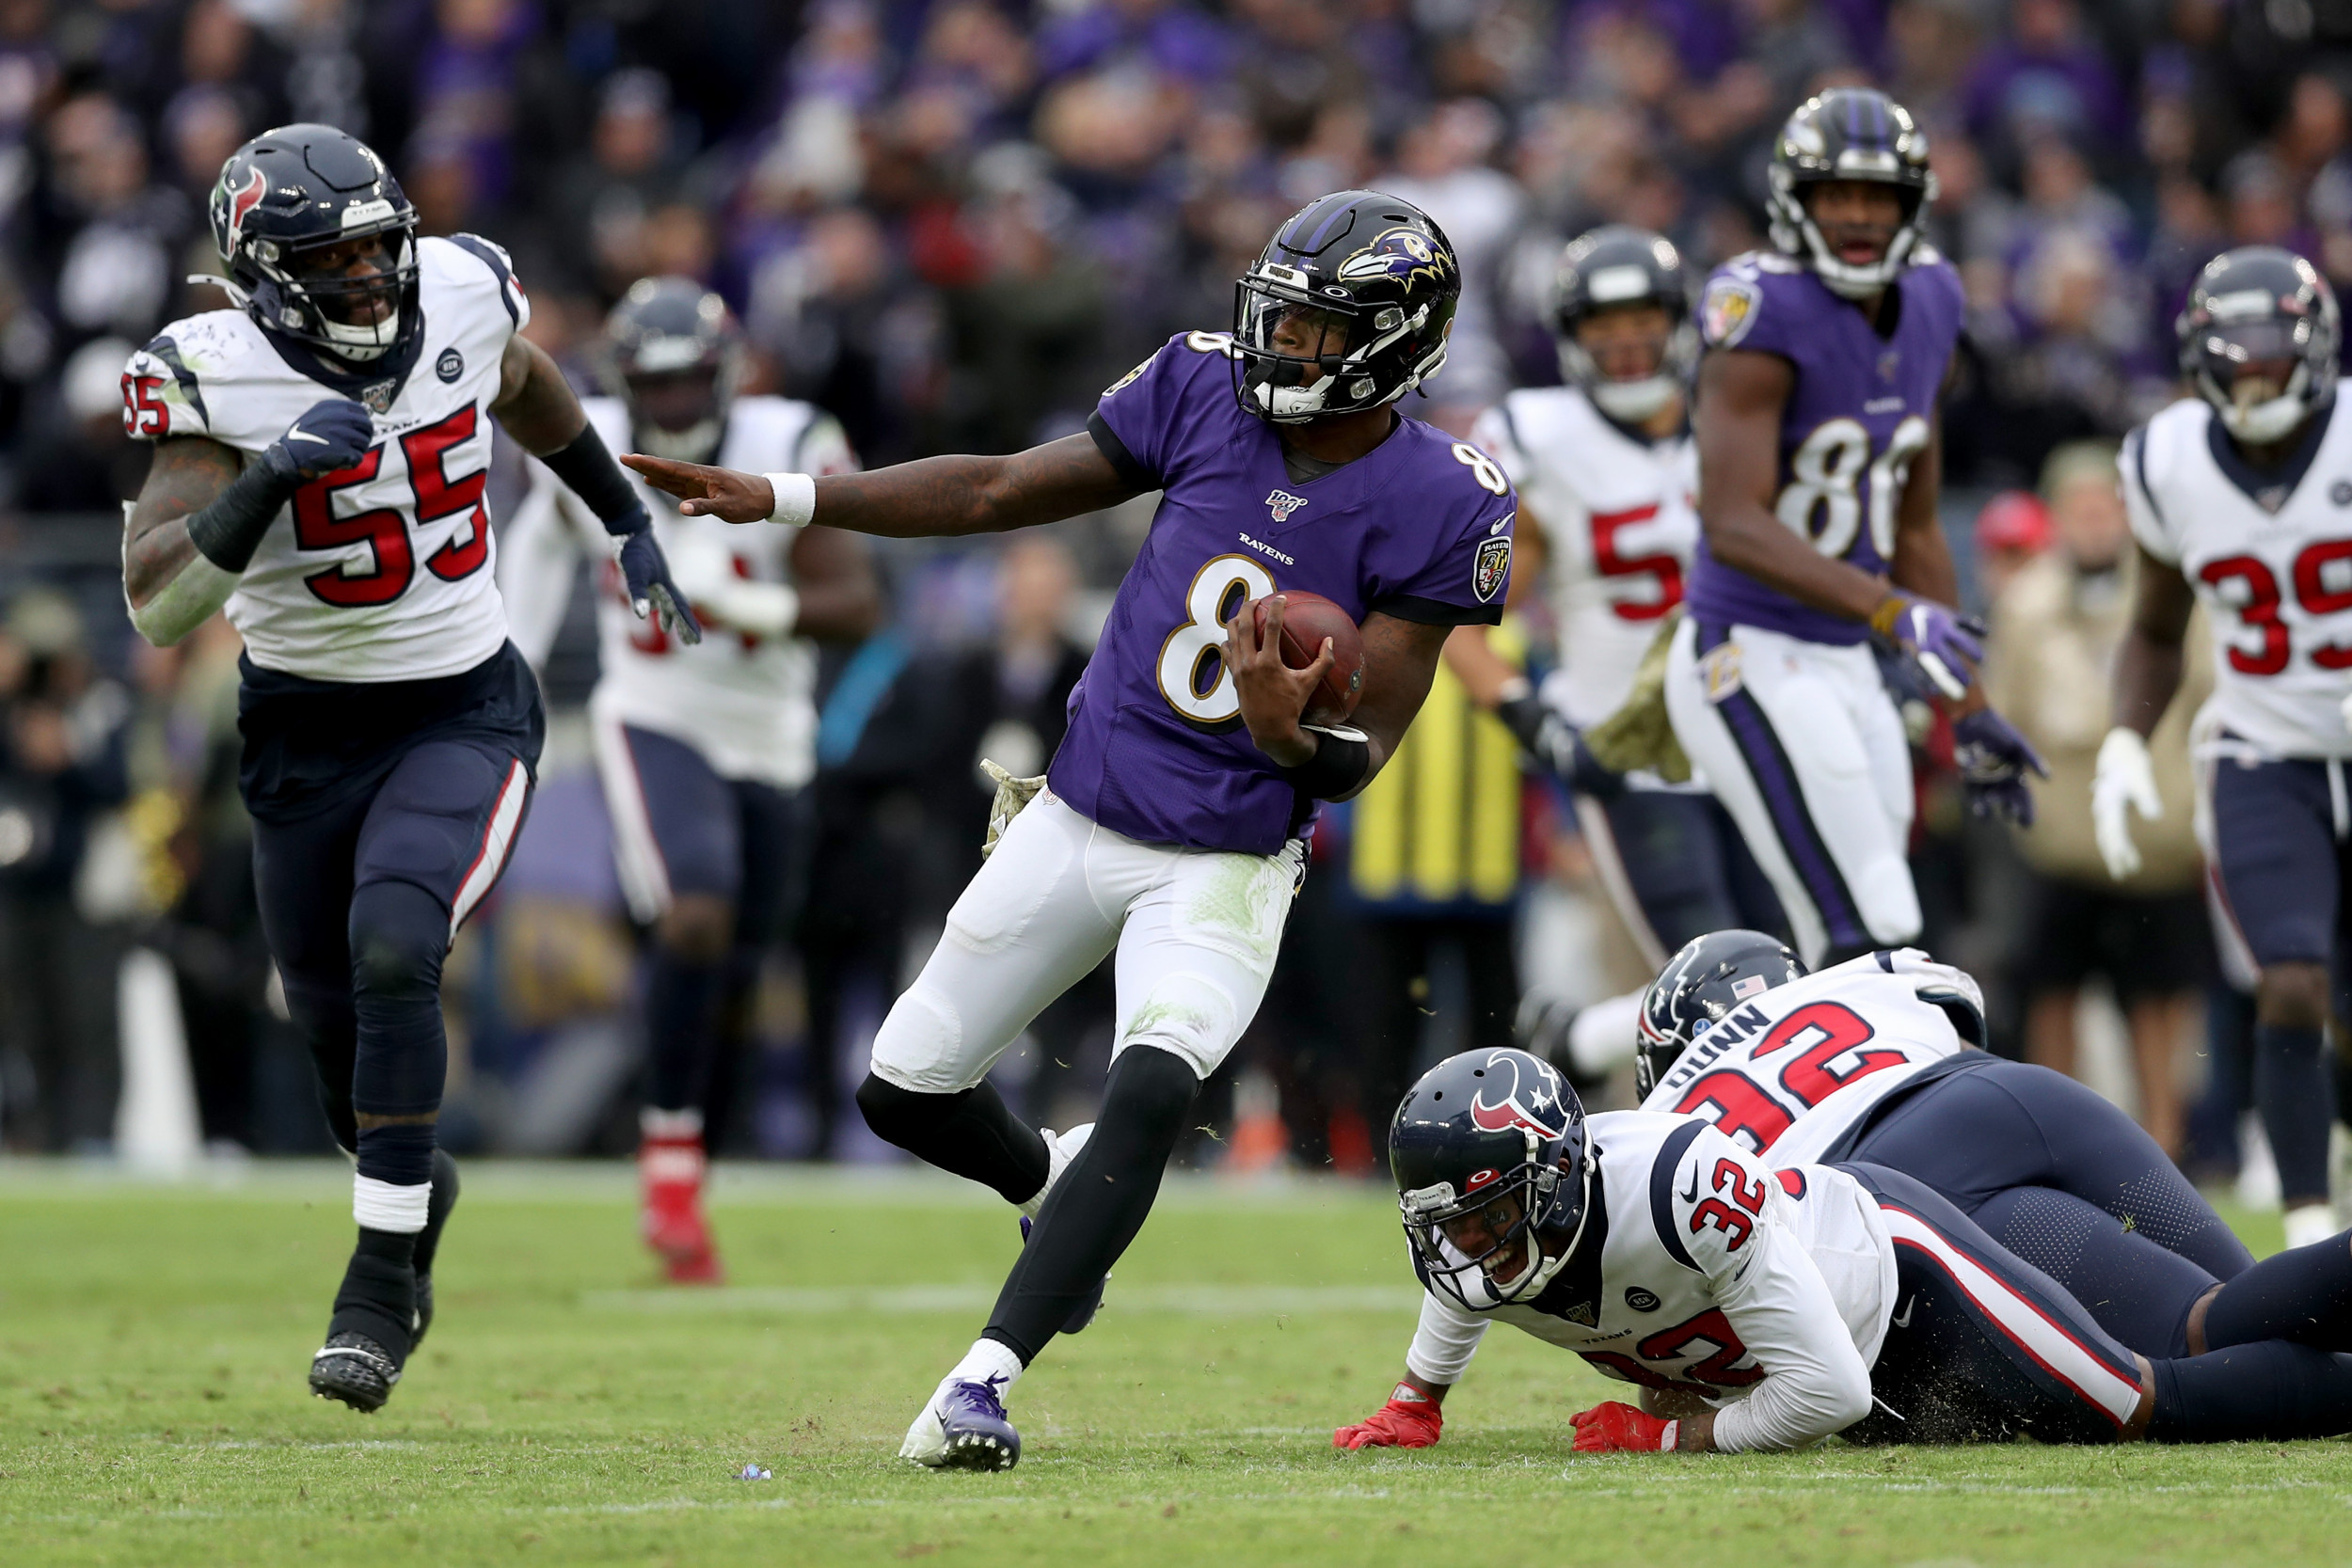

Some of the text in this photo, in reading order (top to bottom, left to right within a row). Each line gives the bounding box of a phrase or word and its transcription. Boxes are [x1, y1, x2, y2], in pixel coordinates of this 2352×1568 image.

[120, 372, 169, 436] 55
[290, 399, 491, 609] 55
[1452, 442, 1508, 497] 8
[1239, 532, 1295, 565] RAVENS
[1157, 553, 1278, 727] 8
[1665, 1004, 1772, 1088] DUNN
[1690, 1157, 1766, 1252] 32
[1581, 1327, 1633, 1345] TEXANS
